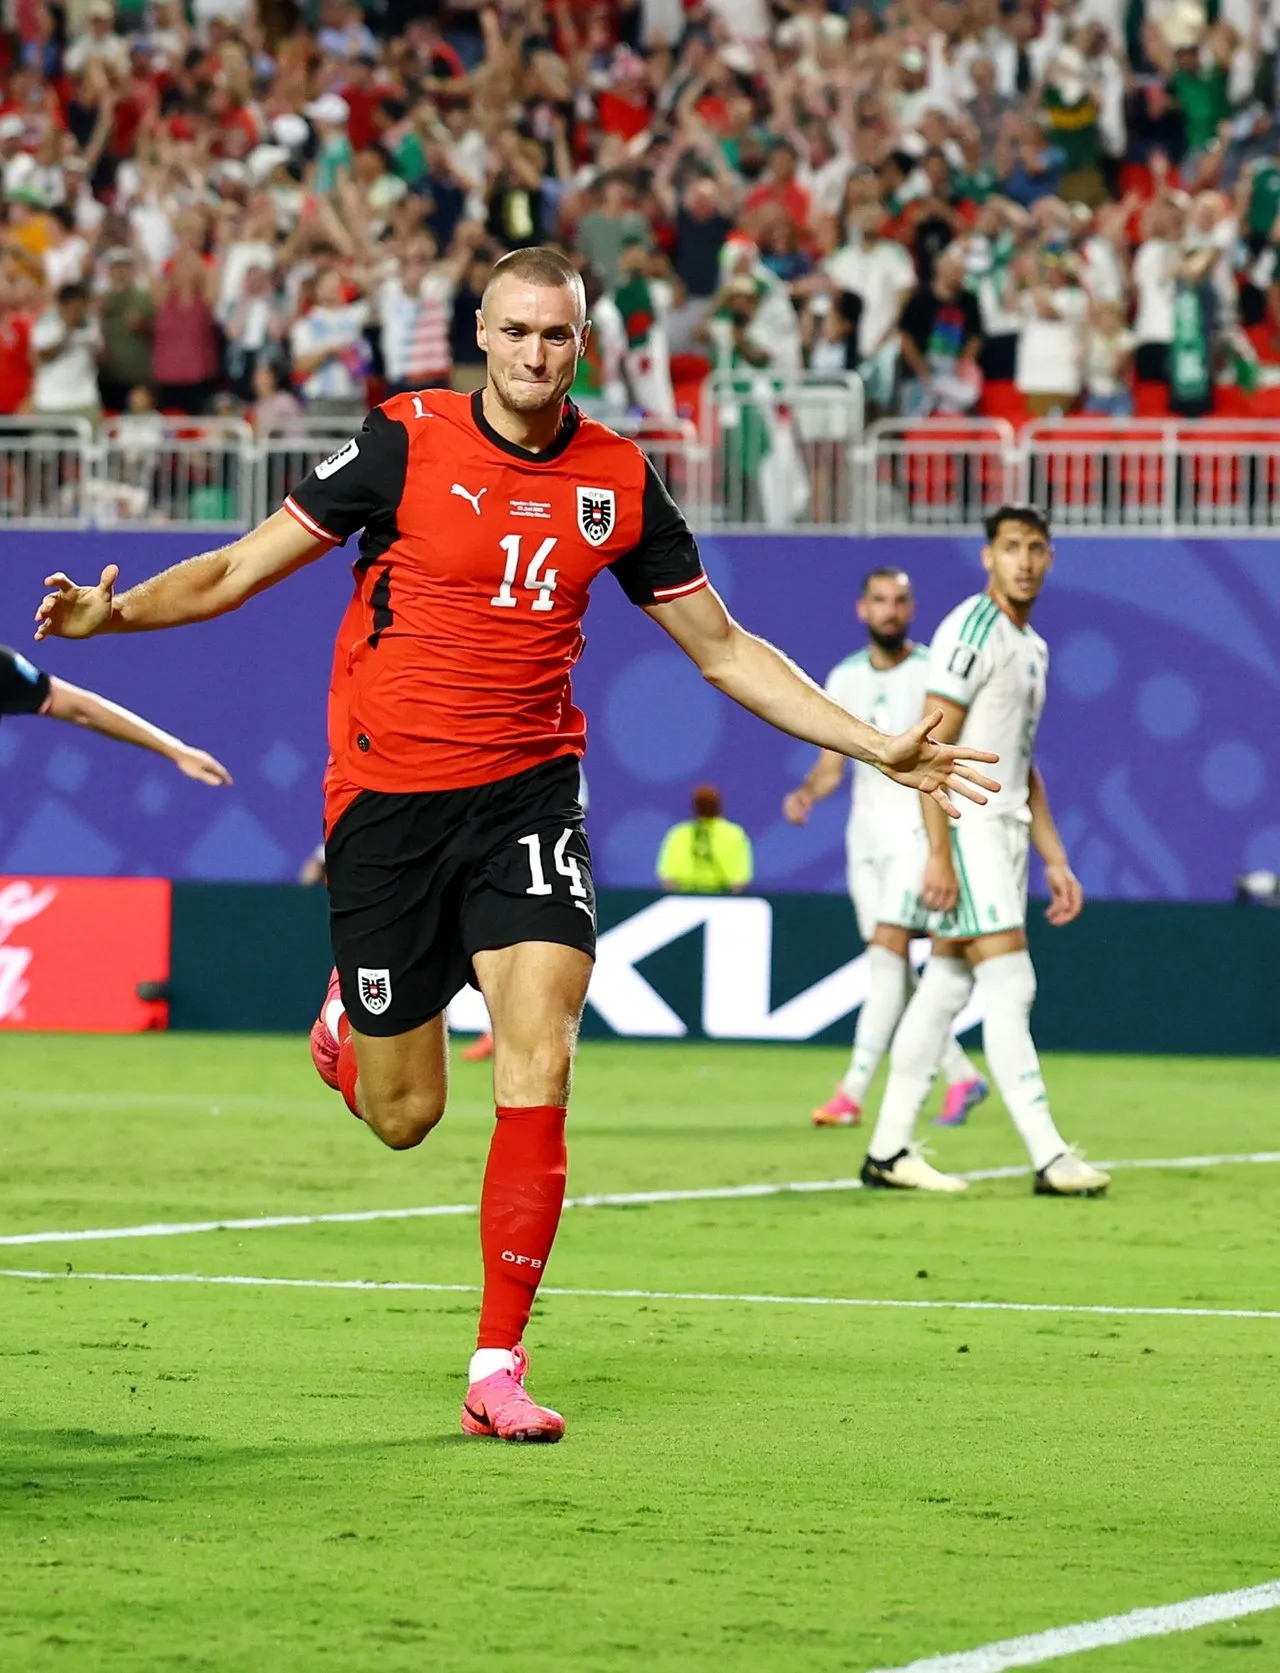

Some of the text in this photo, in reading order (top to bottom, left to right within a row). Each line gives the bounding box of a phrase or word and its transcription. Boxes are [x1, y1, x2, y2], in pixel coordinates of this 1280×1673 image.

[490, 534, 560, 612] 14
[517, 828, 588, 898] 14
[501, 1249, 542, 1269] ÖFB
